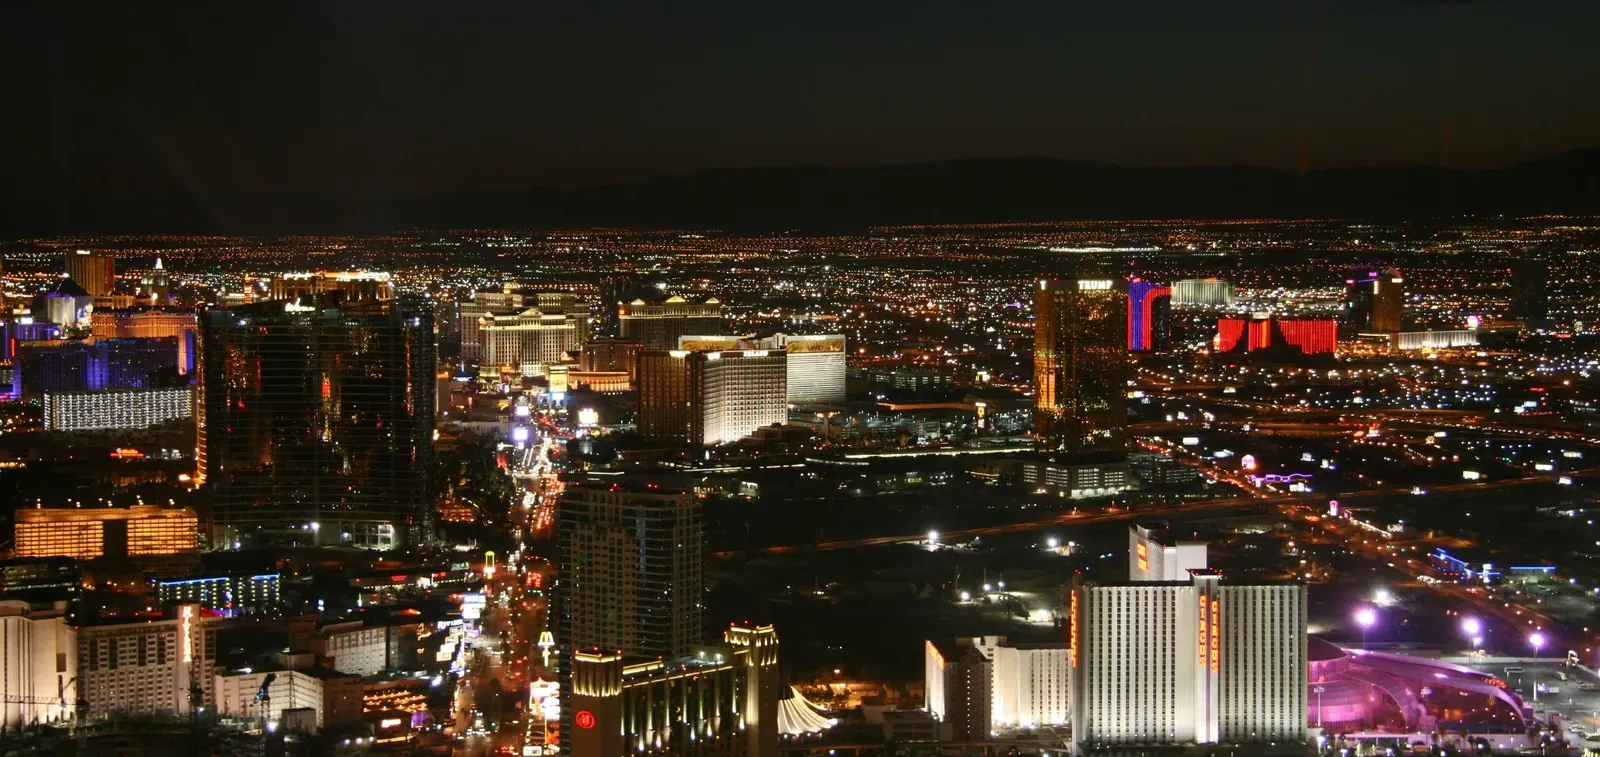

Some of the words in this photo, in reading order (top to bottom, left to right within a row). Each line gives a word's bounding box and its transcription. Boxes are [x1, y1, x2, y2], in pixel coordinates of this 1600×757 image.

[1077, 280, 1113, 290] TRUMP
[1199, 594, 1207, 669] CIRCUS
[1211, 600, 1219, 674] CIRCUS
